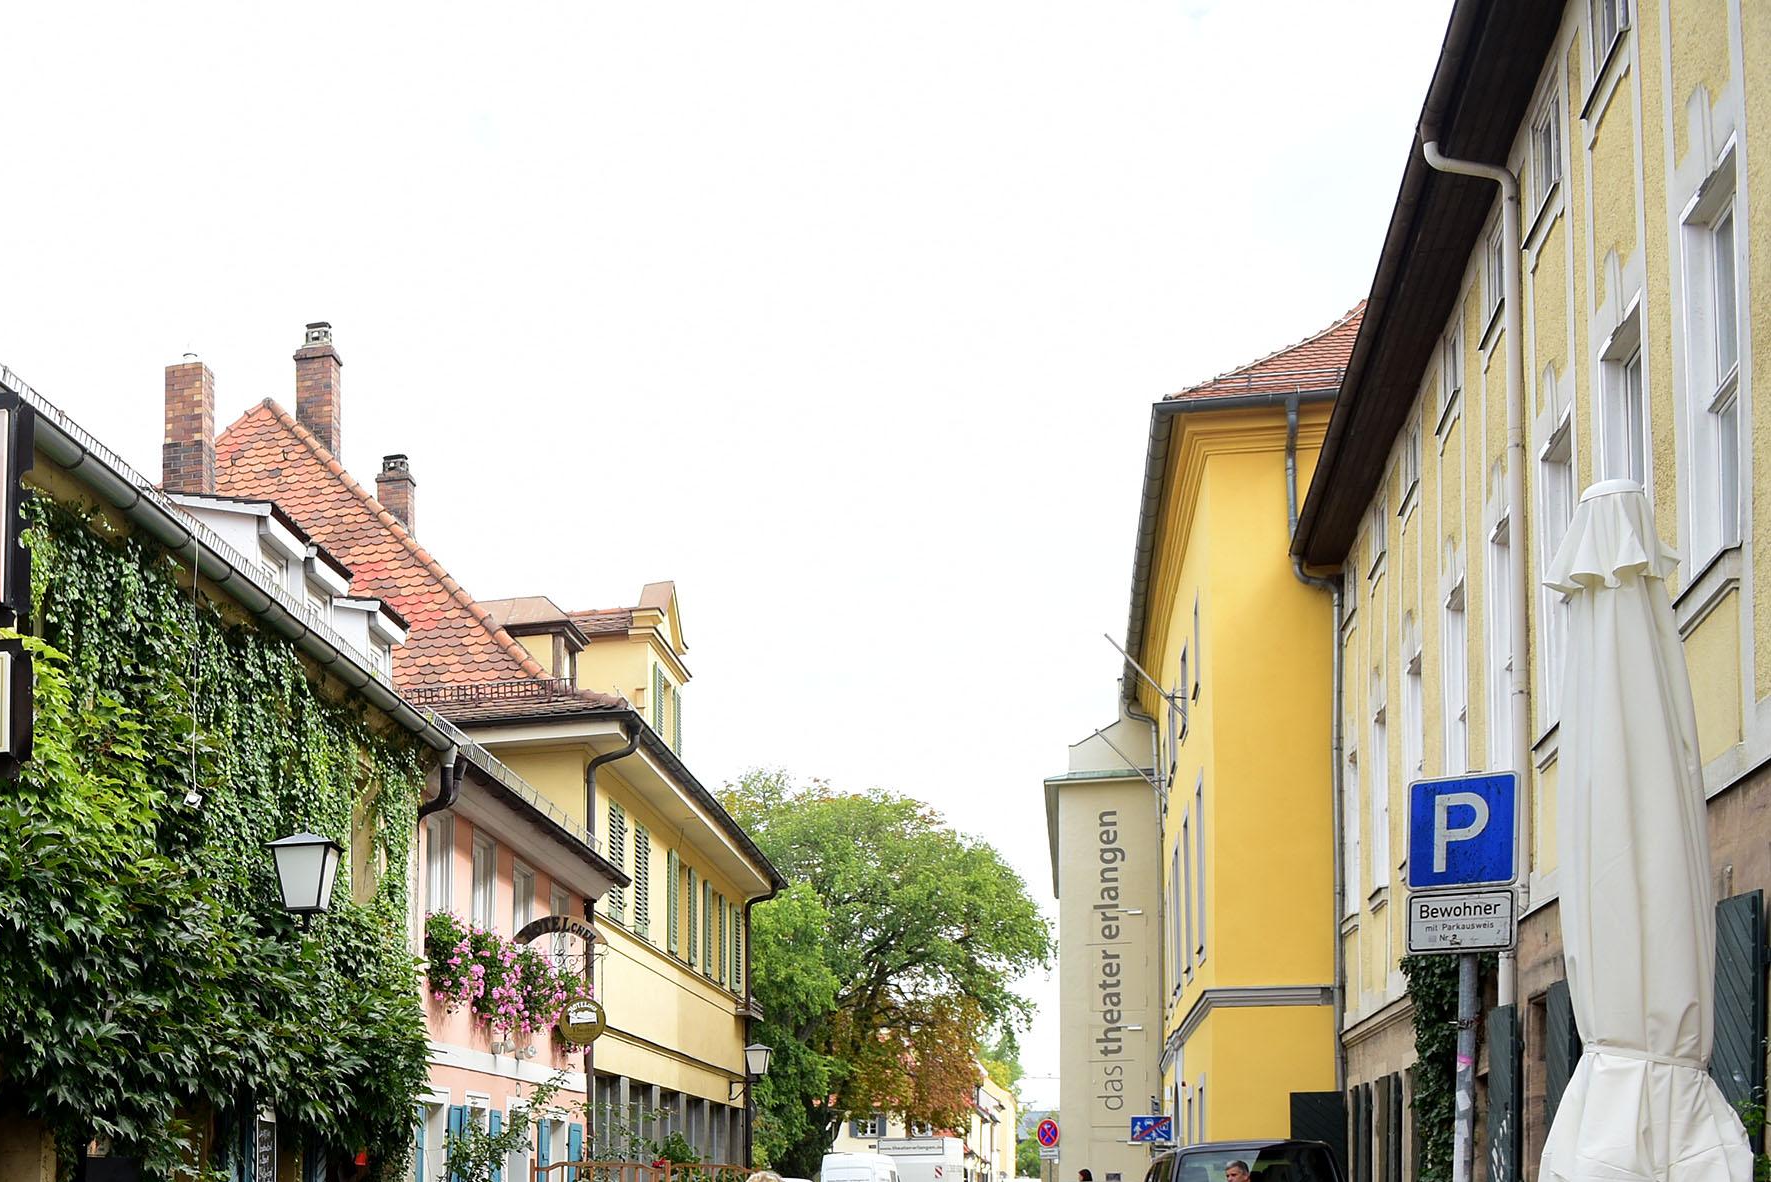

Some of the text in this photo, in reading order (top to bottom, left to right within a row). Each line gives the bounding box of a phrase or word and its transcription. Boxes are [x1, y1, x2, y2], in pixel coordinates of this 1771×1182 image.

[1433, 792, 1489, 873] P
[1419, 902, 1501, 919] Bewohner
[1425, 921, 1495, 932] mit Parkausweis
[1093, 809, 1126, 1111] das theater erlangen
